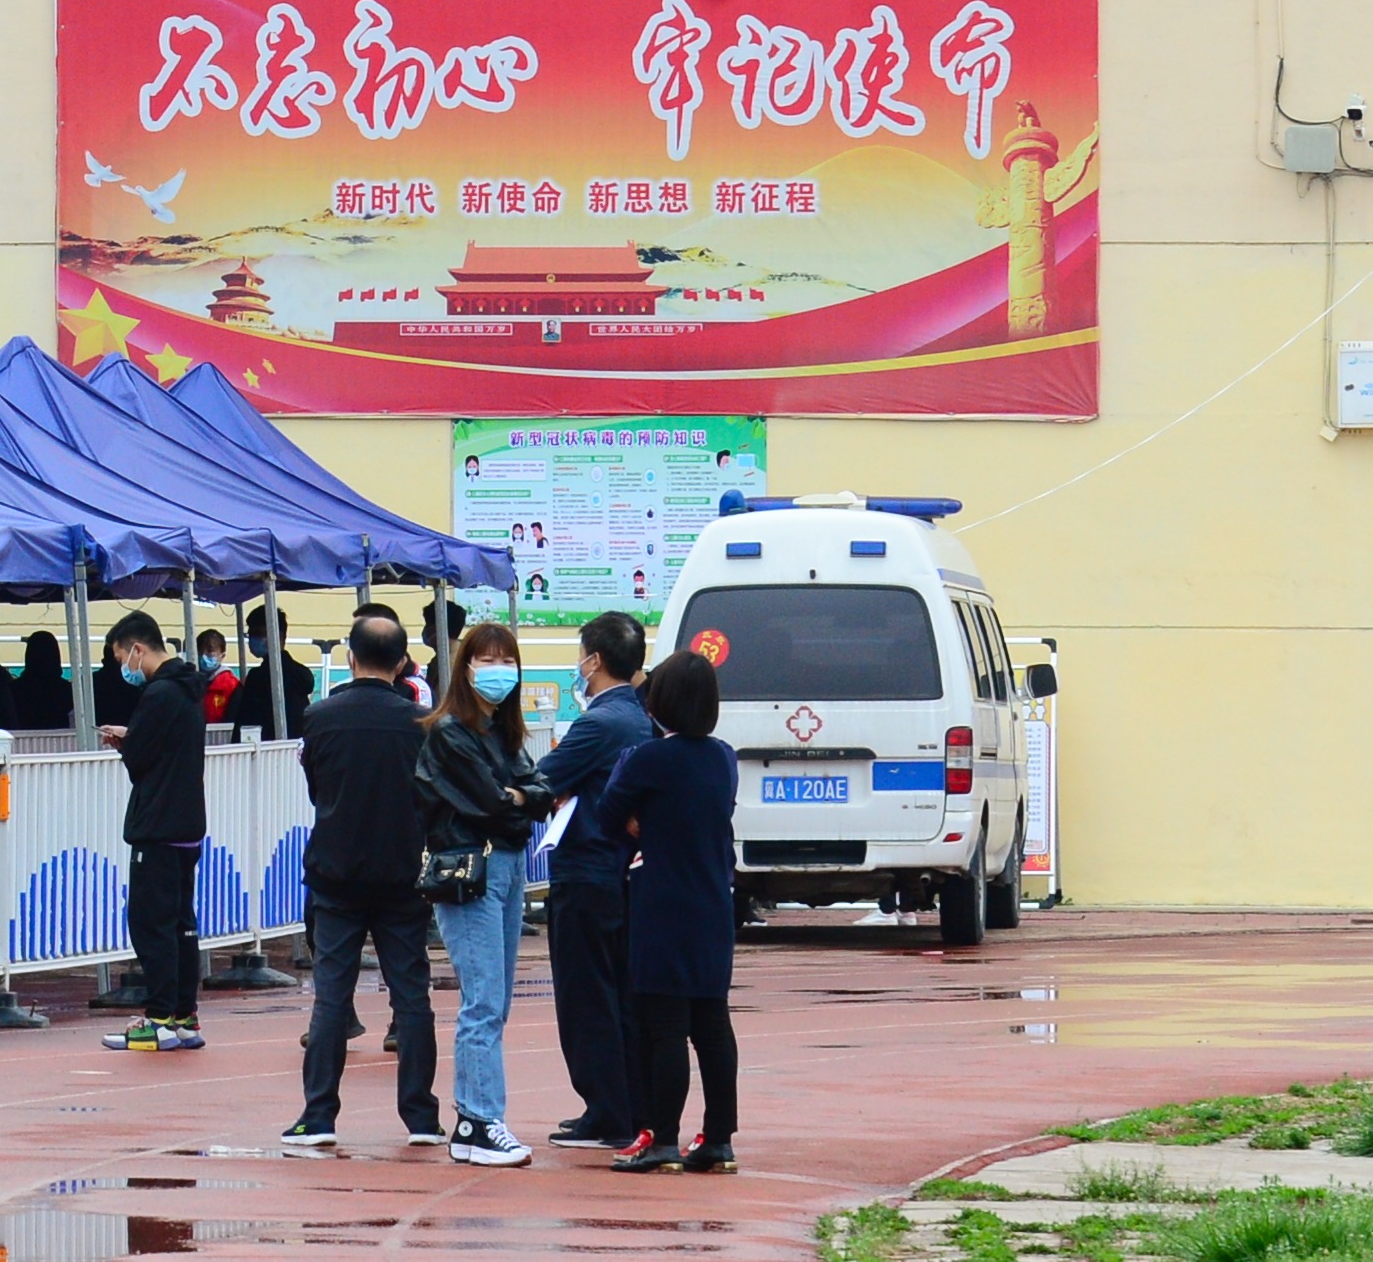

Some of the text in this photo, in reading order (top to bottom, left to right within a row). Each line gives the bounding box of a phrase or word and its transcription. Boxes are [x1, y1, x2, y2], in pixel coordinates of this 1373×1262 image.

[334, 181, 817, 214] 新时代 新使命 新思想 新征程
[510, 429, 707, 448] 新型冠状病毒的预防知识
